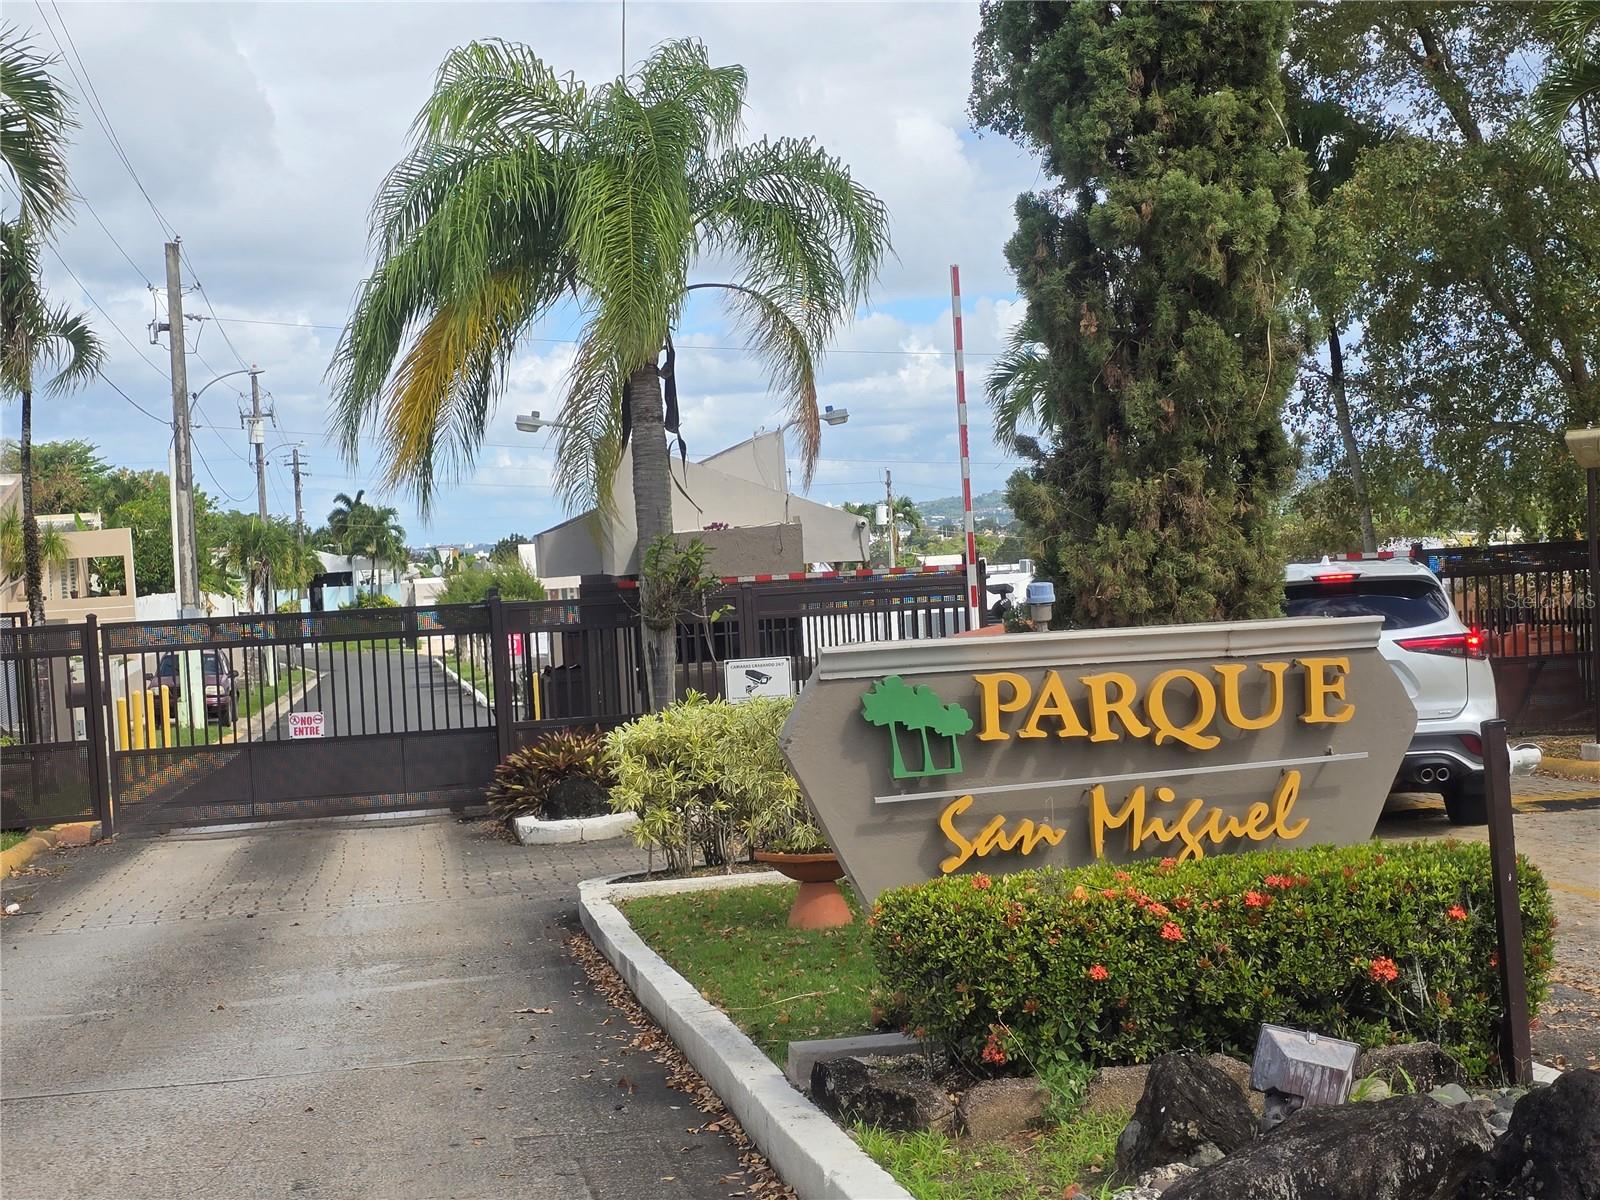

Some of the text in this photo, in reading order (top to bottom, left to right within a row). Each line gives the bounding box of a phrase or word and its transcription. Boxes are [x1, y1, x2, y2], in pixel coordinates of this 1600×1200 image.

[300, 716, 313, 726] NO
[972, 657, 1355, 750] PARQUE
[294, 726, 320, 736] ENTRE
[938, 770, 1309, 874] San Miguel
